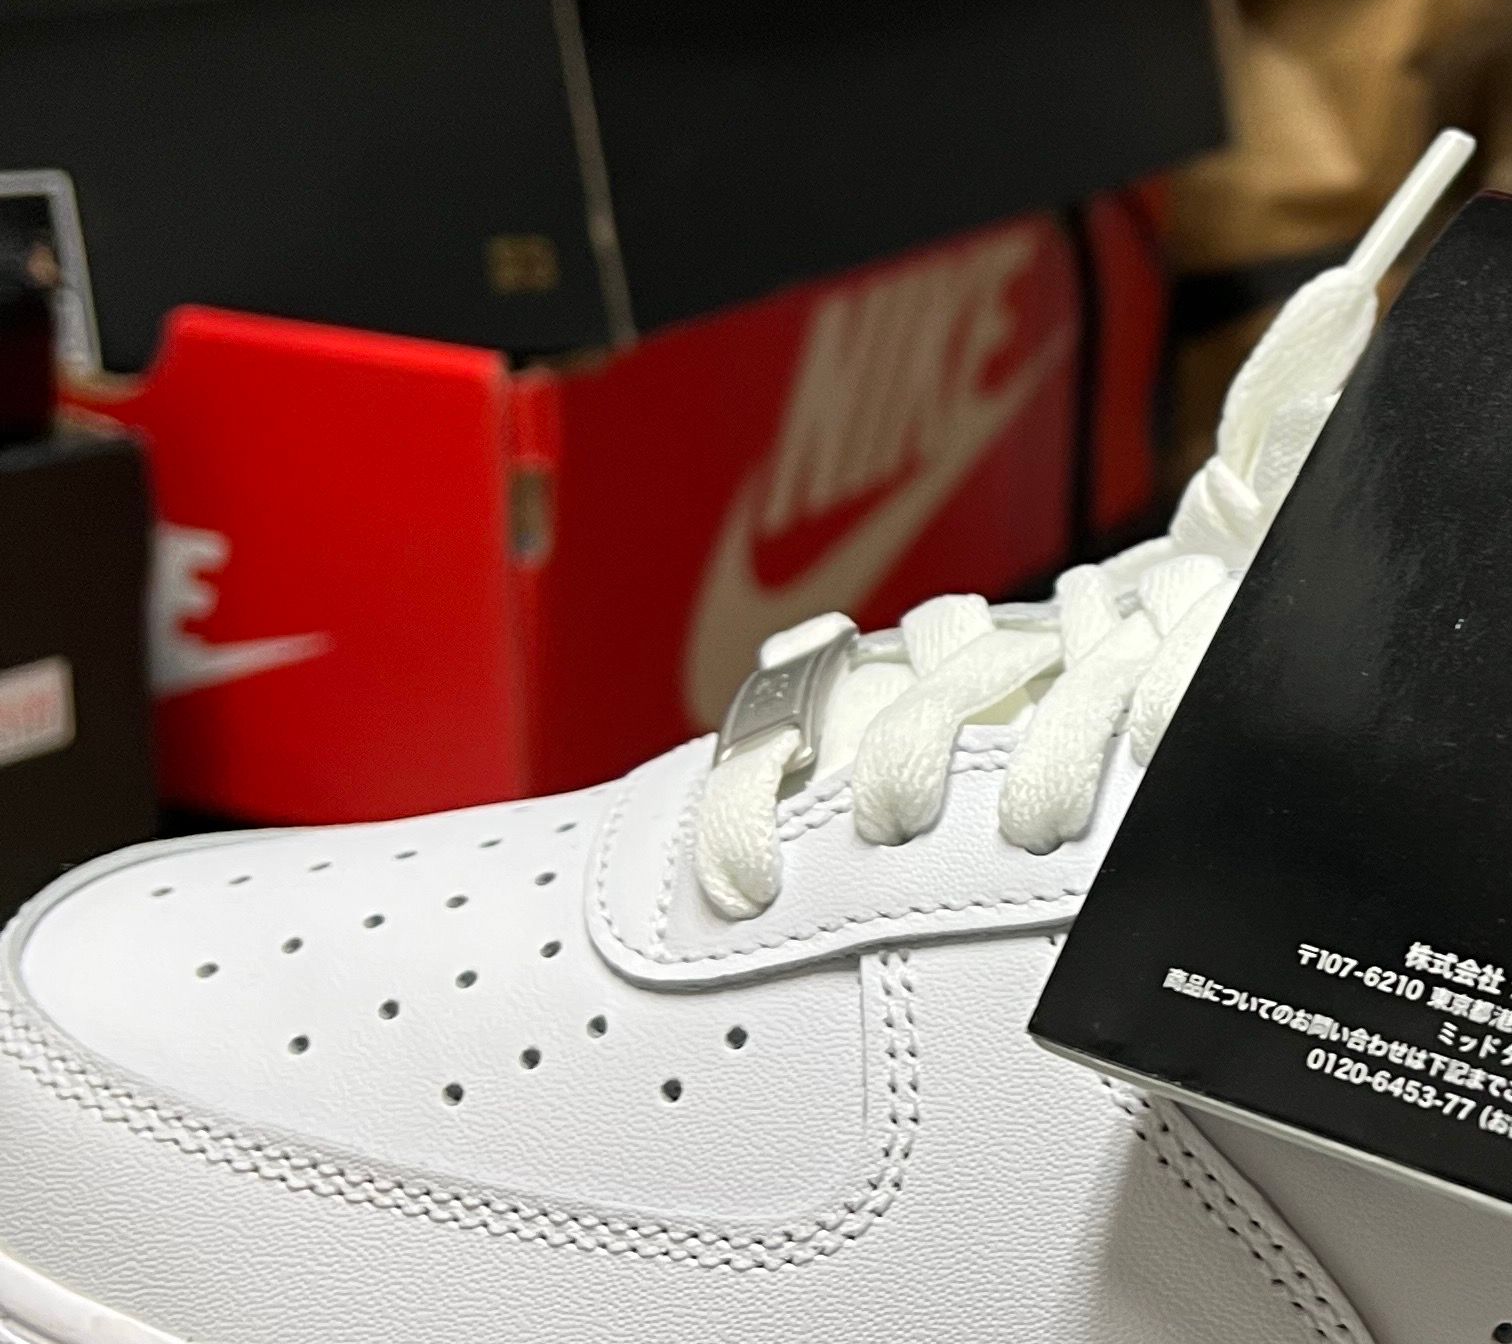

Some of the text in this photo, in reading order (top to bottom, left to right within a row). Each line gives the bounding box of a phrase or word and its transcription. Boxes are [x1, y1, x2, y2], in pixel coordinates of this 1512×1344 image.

[1405, 942, 1505, 994] 株式会社
[1306, 1048, 1477, 1120] 0120-6453-77
